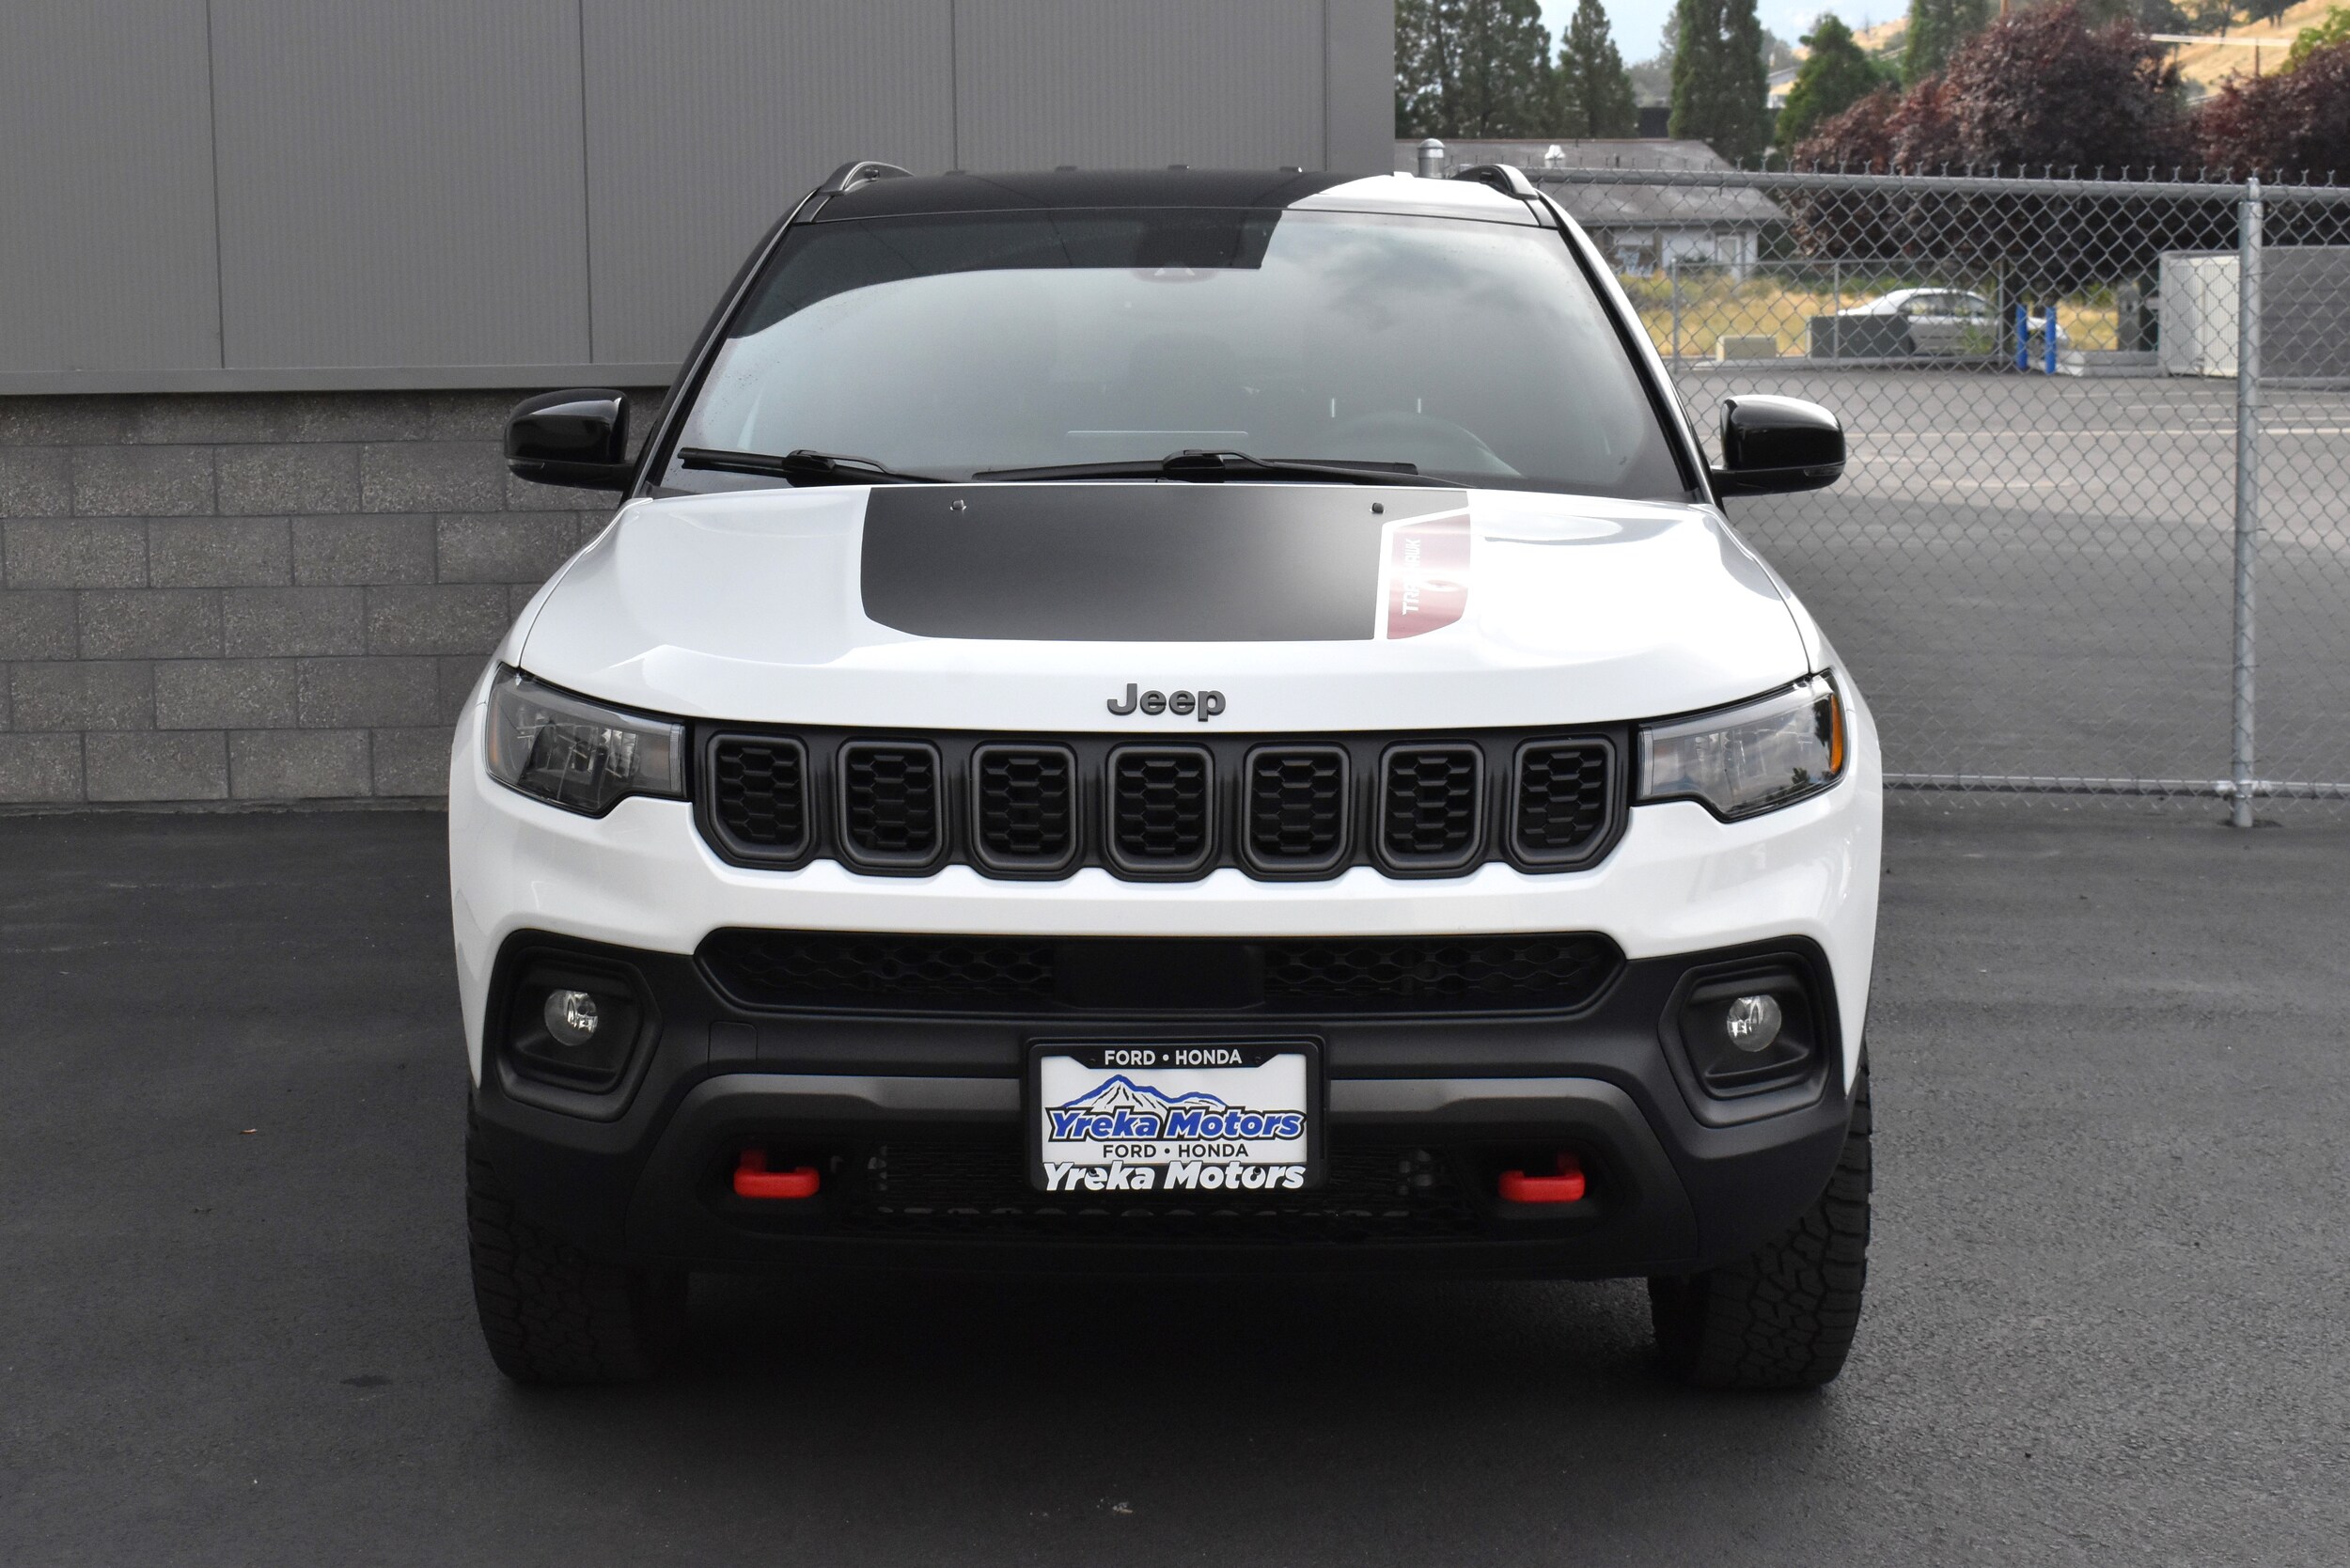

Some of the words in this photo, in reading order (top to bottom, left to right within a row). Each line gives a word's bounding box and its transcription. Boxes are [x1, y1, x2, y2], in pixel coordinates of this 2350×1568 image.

[1402, 538, 1421, 616] TRAHAWK
[1106, 682, 1227, 723] Jeep
[1104, 1049, 1156, 1066] FORD
[1175, 1048, 1243, 1065] HONDA
[1048, 1107, 1160, 1139] Yreka
[1164, 1107, 1305, 1139] Motors
[1103, 1144, 1156, 1158] FORD
[1178, 1143, 1249, 1158] HONDA
[1042, 1160, 1156, 1191] Yreka
[1163, 1160, 1307, 1190] Motors
